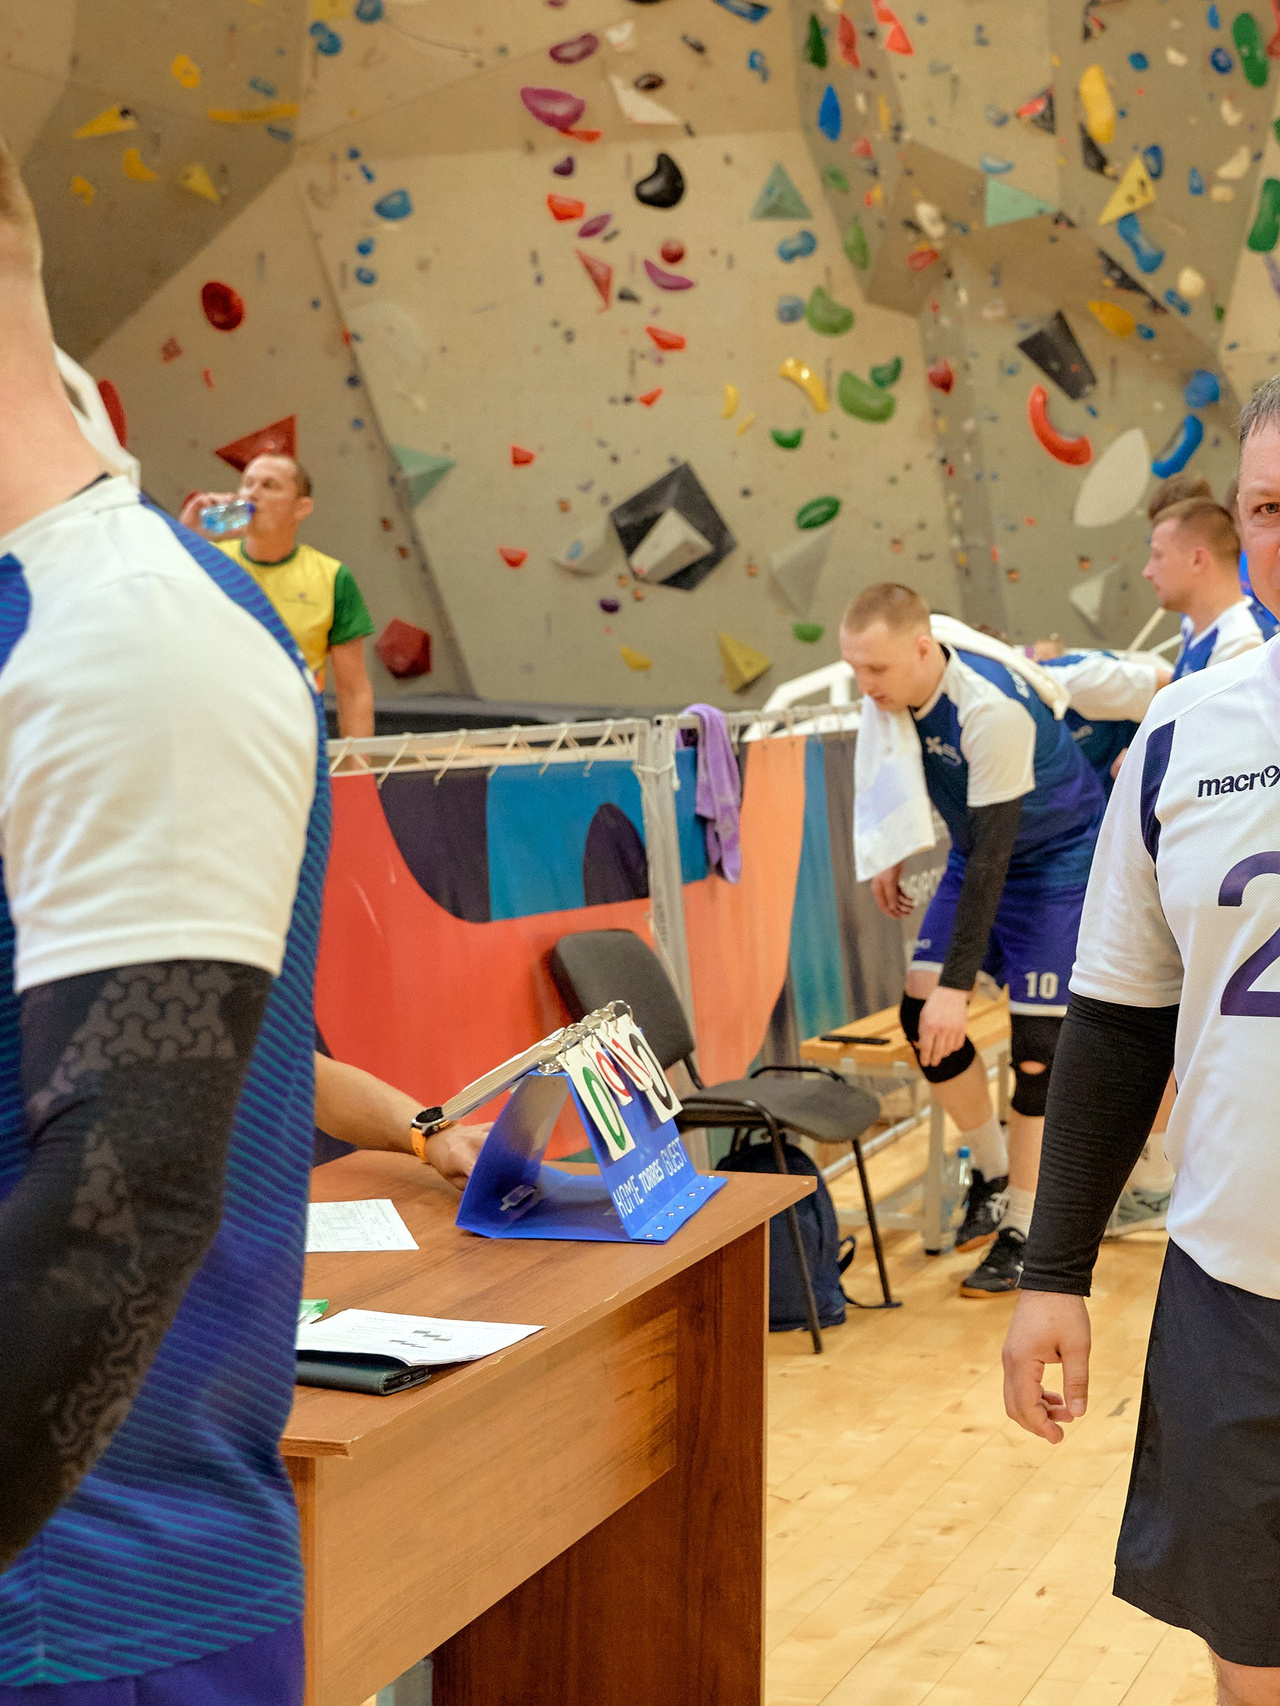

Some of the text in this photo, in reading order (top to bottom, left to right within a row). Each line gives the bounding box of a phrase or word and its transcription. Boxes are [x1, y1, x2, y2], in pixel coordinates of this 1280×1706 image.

[1025, 972, 1058, 999] 10
[612, 1136, 688, 1219] HOME TORRES GUEST
